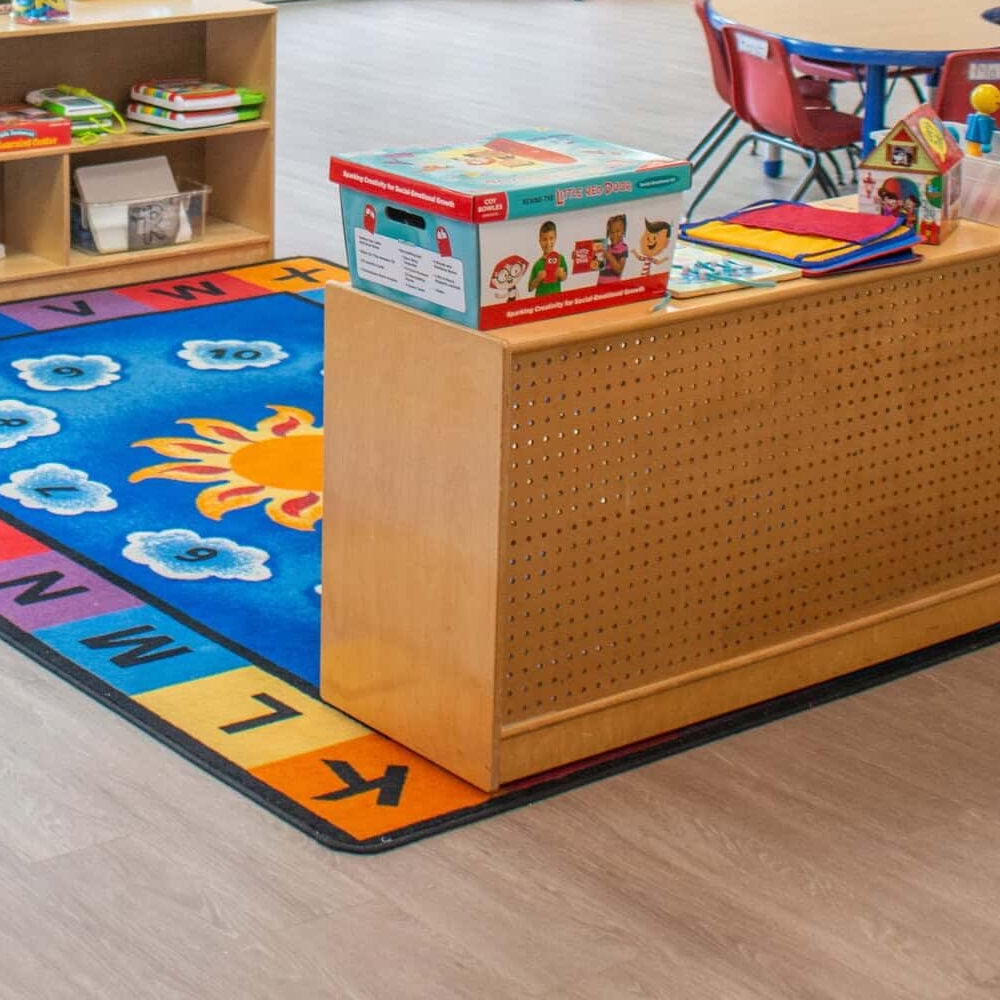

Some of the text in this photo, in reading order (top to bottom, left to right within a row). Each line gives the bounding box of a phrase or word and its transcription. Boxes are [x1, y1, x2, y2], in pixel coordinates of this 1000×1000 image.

[478, 203, 504, 213] BOWLES
[555, 186, 583, 207] LITTLE
[585, 184, 603, 198] RED
[41, 299, 99, 318] V
[146, 281, 228, 302] W
[278, 264, 328, 283] X
[534, 301, 564, 314] Creativity
[564, 298, 574, 308] for
[210, 347, 263, 363] 10
[79, 624, 194, 669] M
[219, 692, 304, 735] L
[311, 757, 410, 808] K
